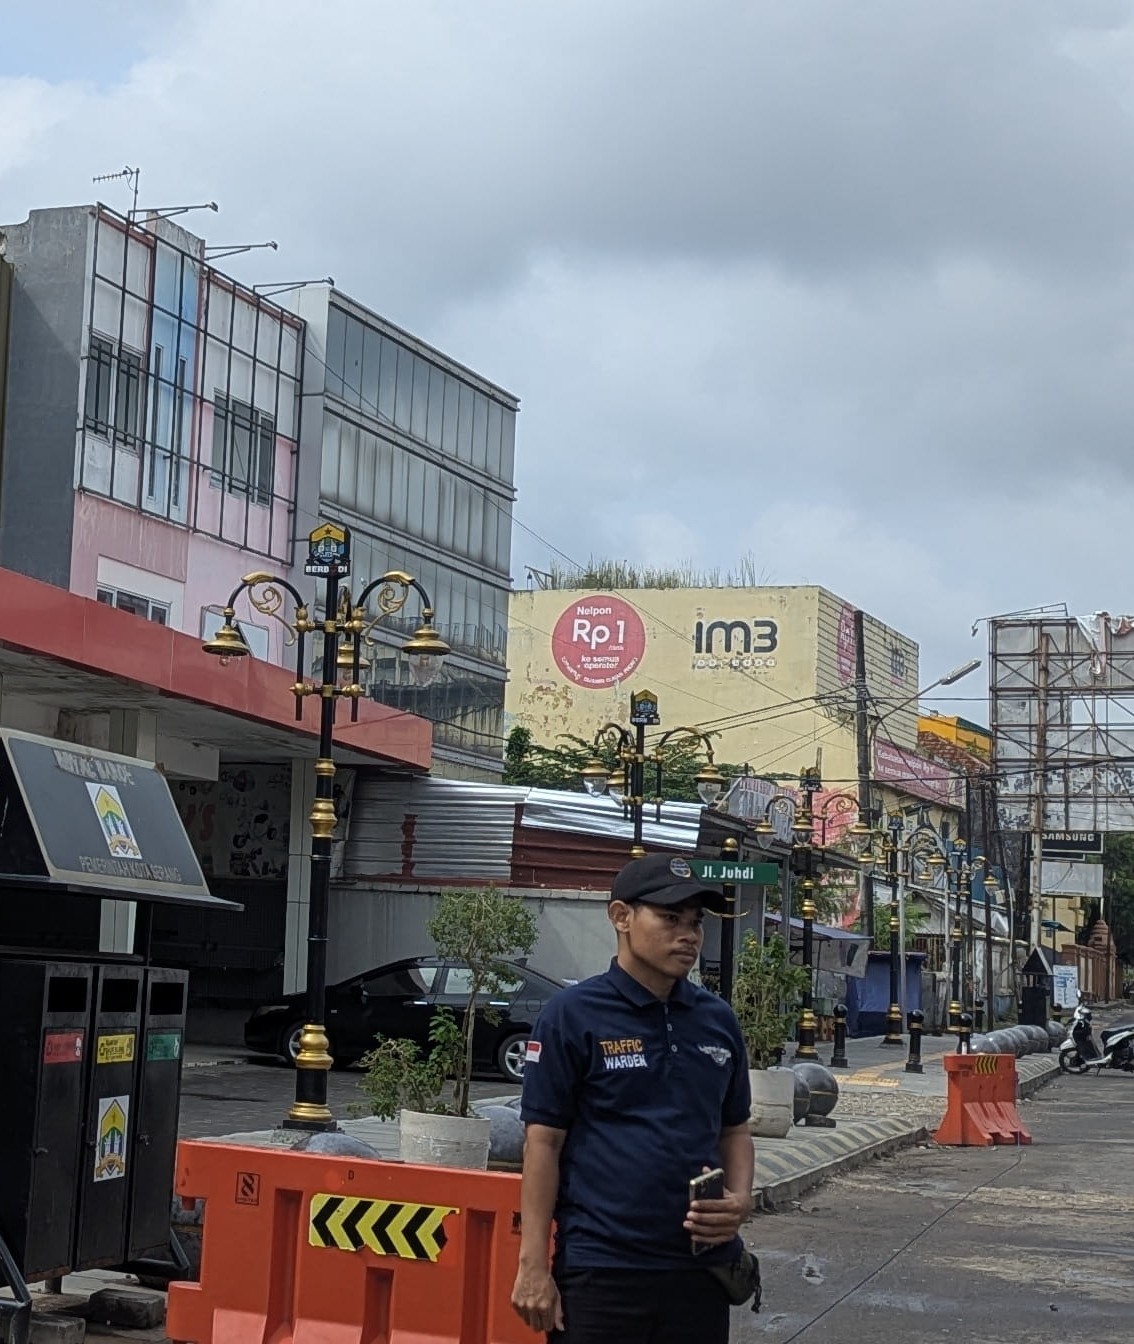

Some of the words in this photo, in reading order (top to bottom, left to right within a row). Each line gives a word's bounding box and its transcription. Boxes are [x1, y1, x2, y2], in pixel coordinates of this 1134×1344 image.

[577, 606, 612, 617] Nelpon
[572, 618, 610, 650] Rp
[702, 865, 716, 878] Jl.
[720, 866, 754, 880] Juhdi
[600, 1039, 643, 1056] TRAFFIC
[603, 1054, 647, 1070] WARDEN
